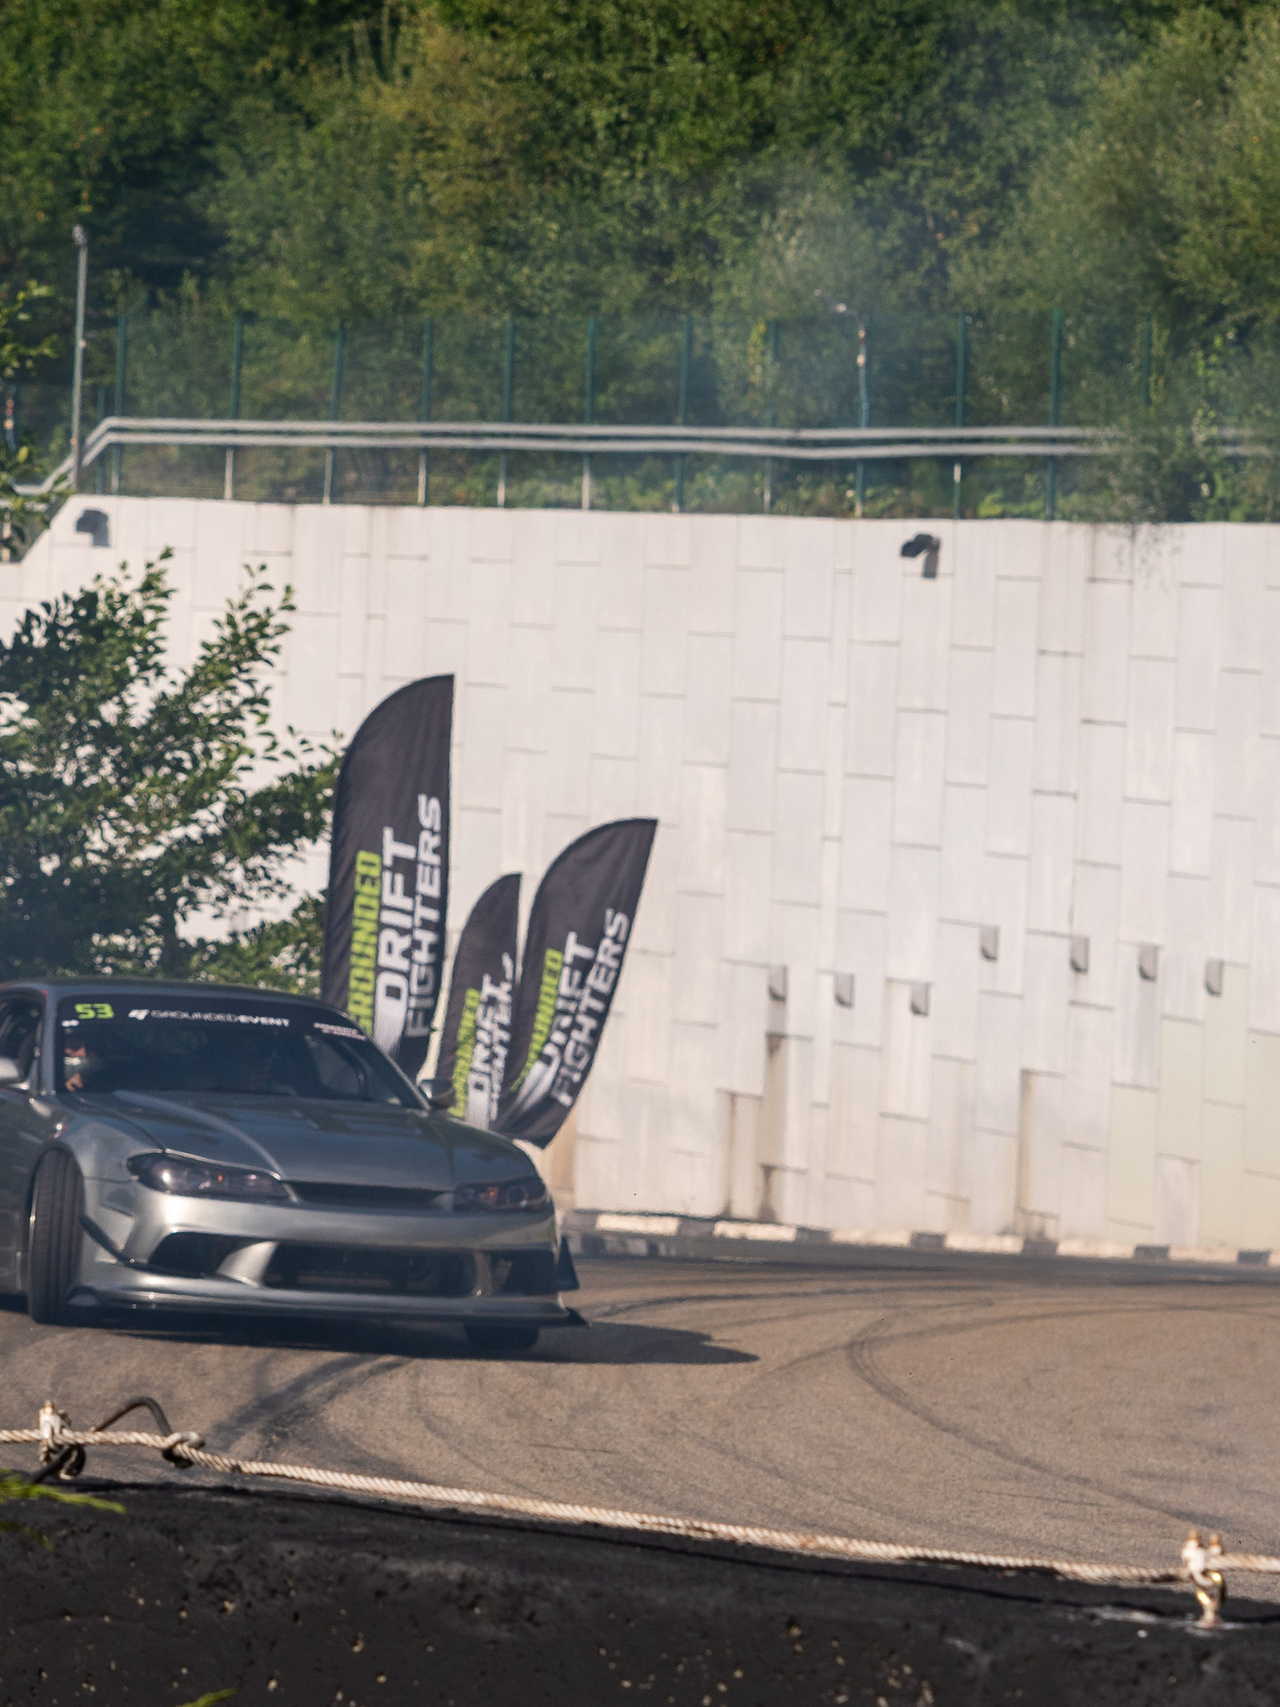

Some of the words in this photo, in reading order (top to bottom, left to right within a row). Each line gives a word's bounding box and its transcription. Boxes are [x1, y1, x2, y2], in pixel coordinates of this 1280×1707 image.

[75, 1003, 115, 1019] 53
[375, 826, 417, 1058] DRIFT
[405, 794, 442, 1038] FIGHTERS
[551, 908, 630, 1107] FIGHTERS
